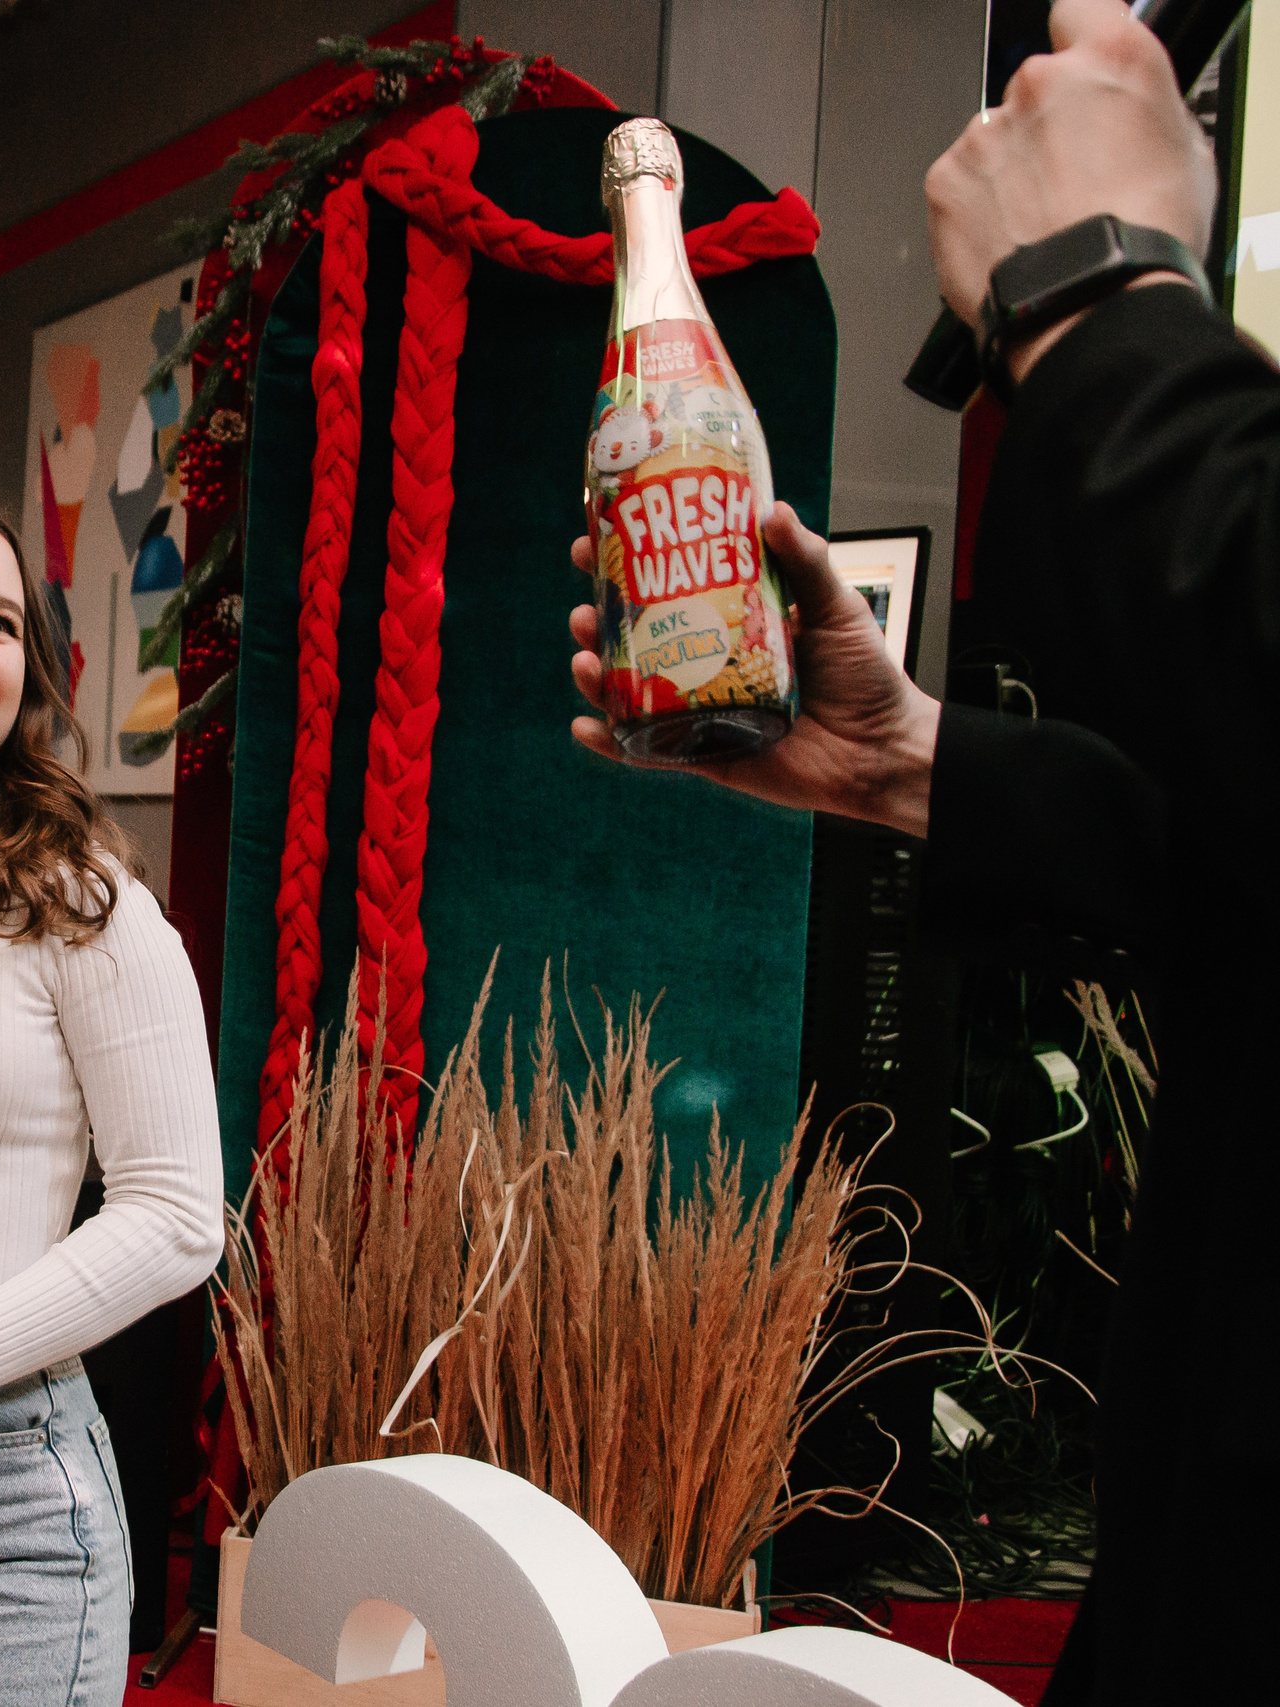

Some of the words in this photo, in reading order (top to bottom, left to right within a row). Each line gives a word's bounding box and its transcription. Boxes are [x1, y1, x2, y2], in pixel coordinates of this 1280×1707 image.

[618, 475, 751, 552] FRESH
[632, 534, 755, 598] WAVE'S
[648, 610, 690, 638] ВКУС
